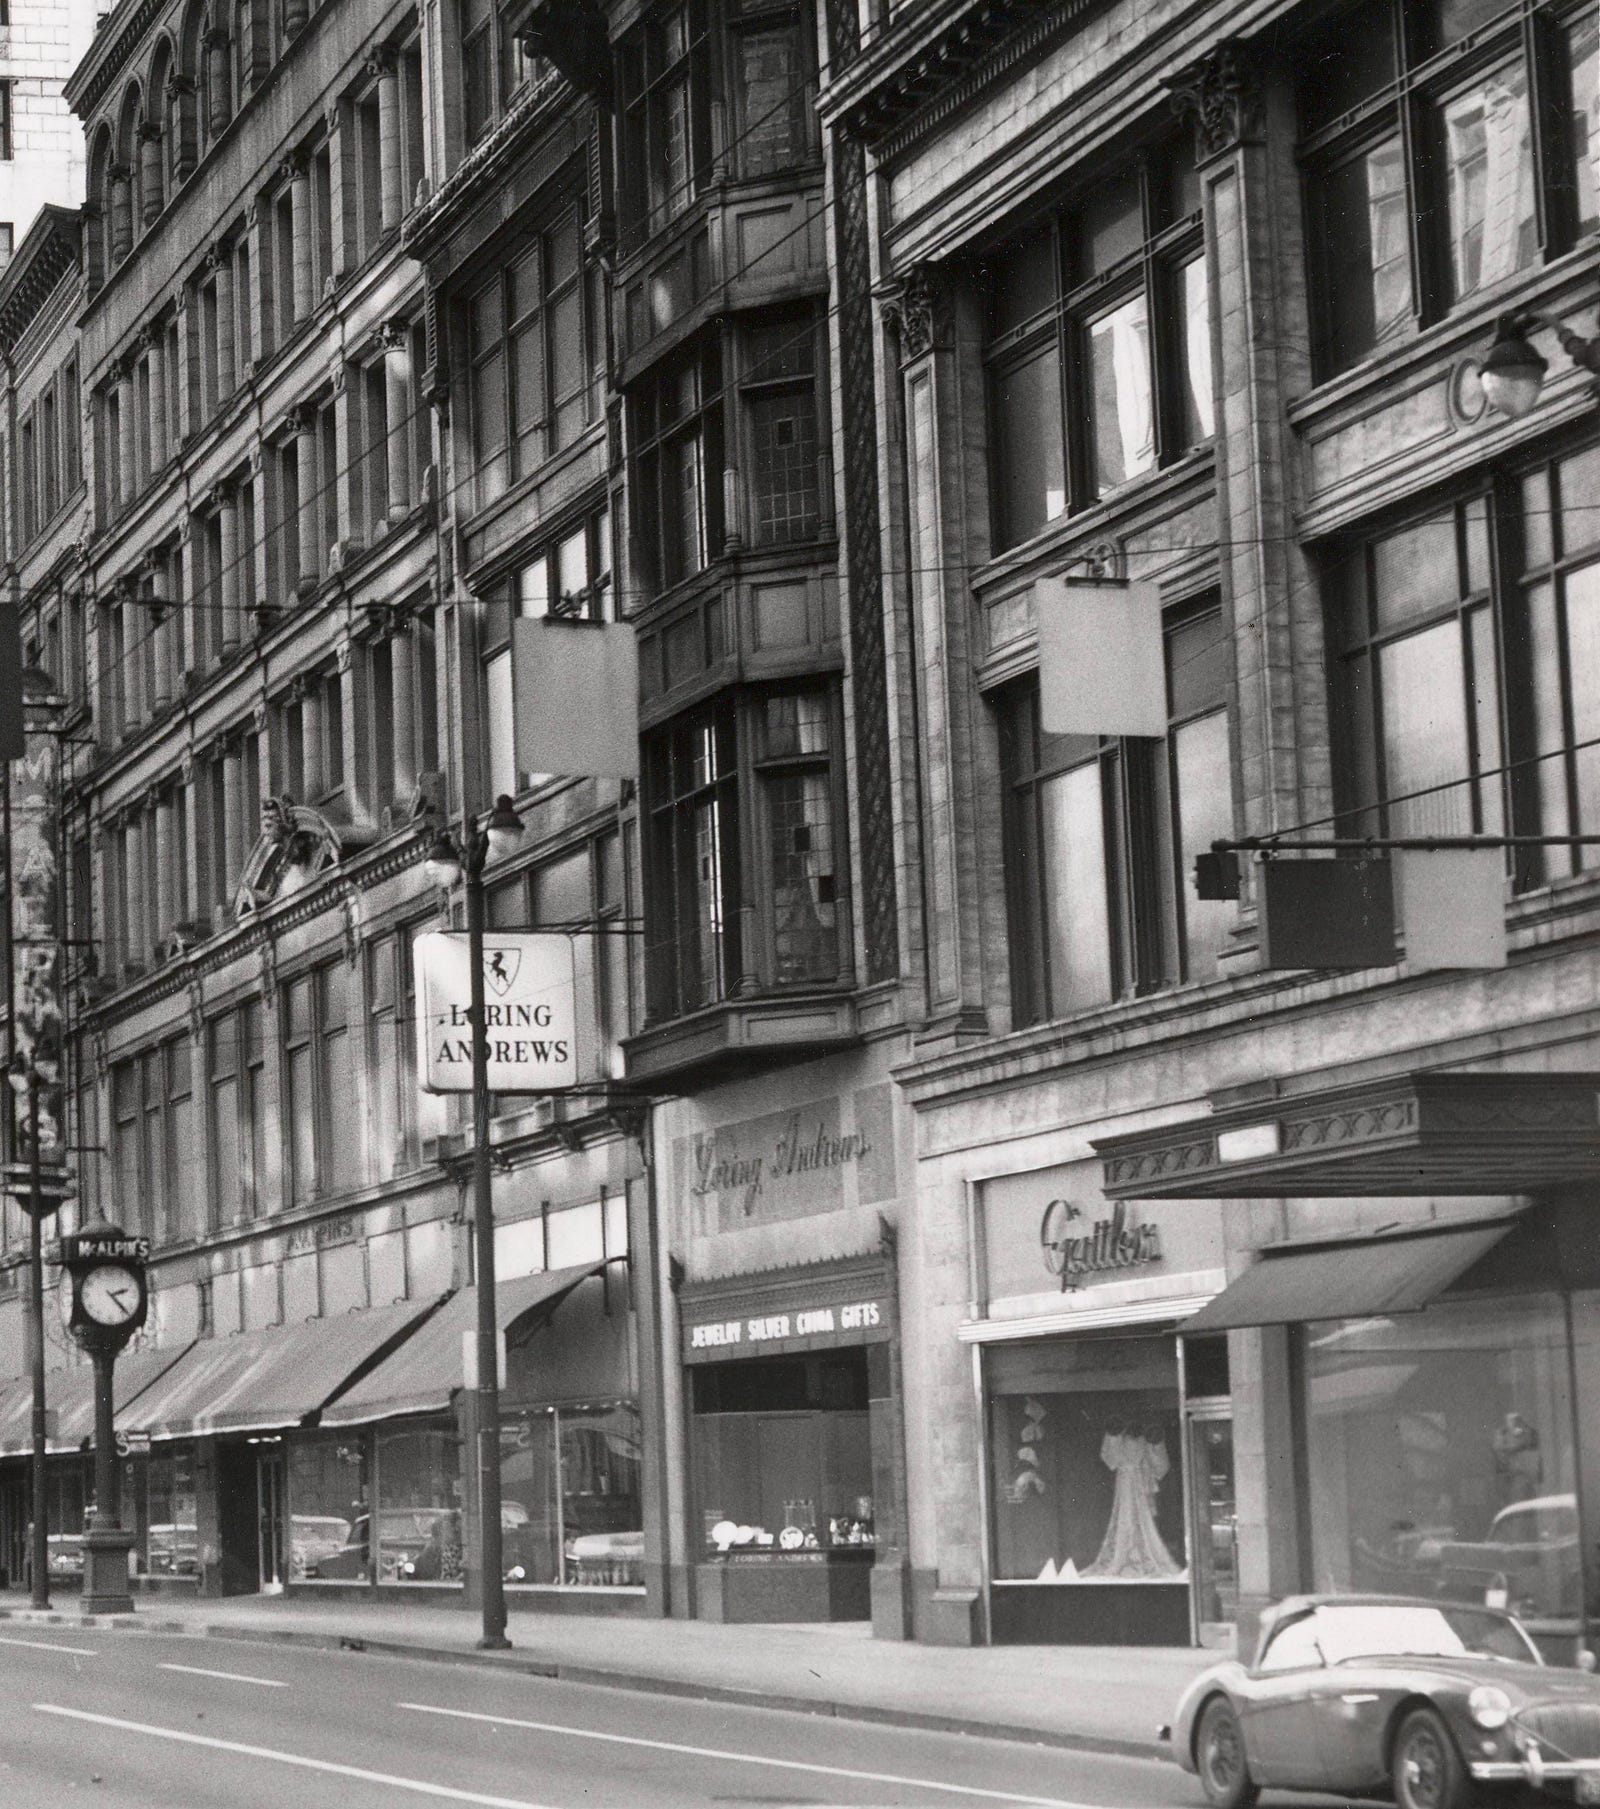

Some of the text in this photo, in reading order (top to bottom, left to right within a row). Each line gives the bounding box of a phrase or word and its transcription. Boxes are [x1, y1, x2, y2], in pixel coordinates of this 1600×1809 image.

[450, 1004, 552, 1027] LRING
[690, 1113, 872, 1217] Loring Andrews
[692, 1302, 880, 1347] JEWELRY SILVER CHINA GIFTS
